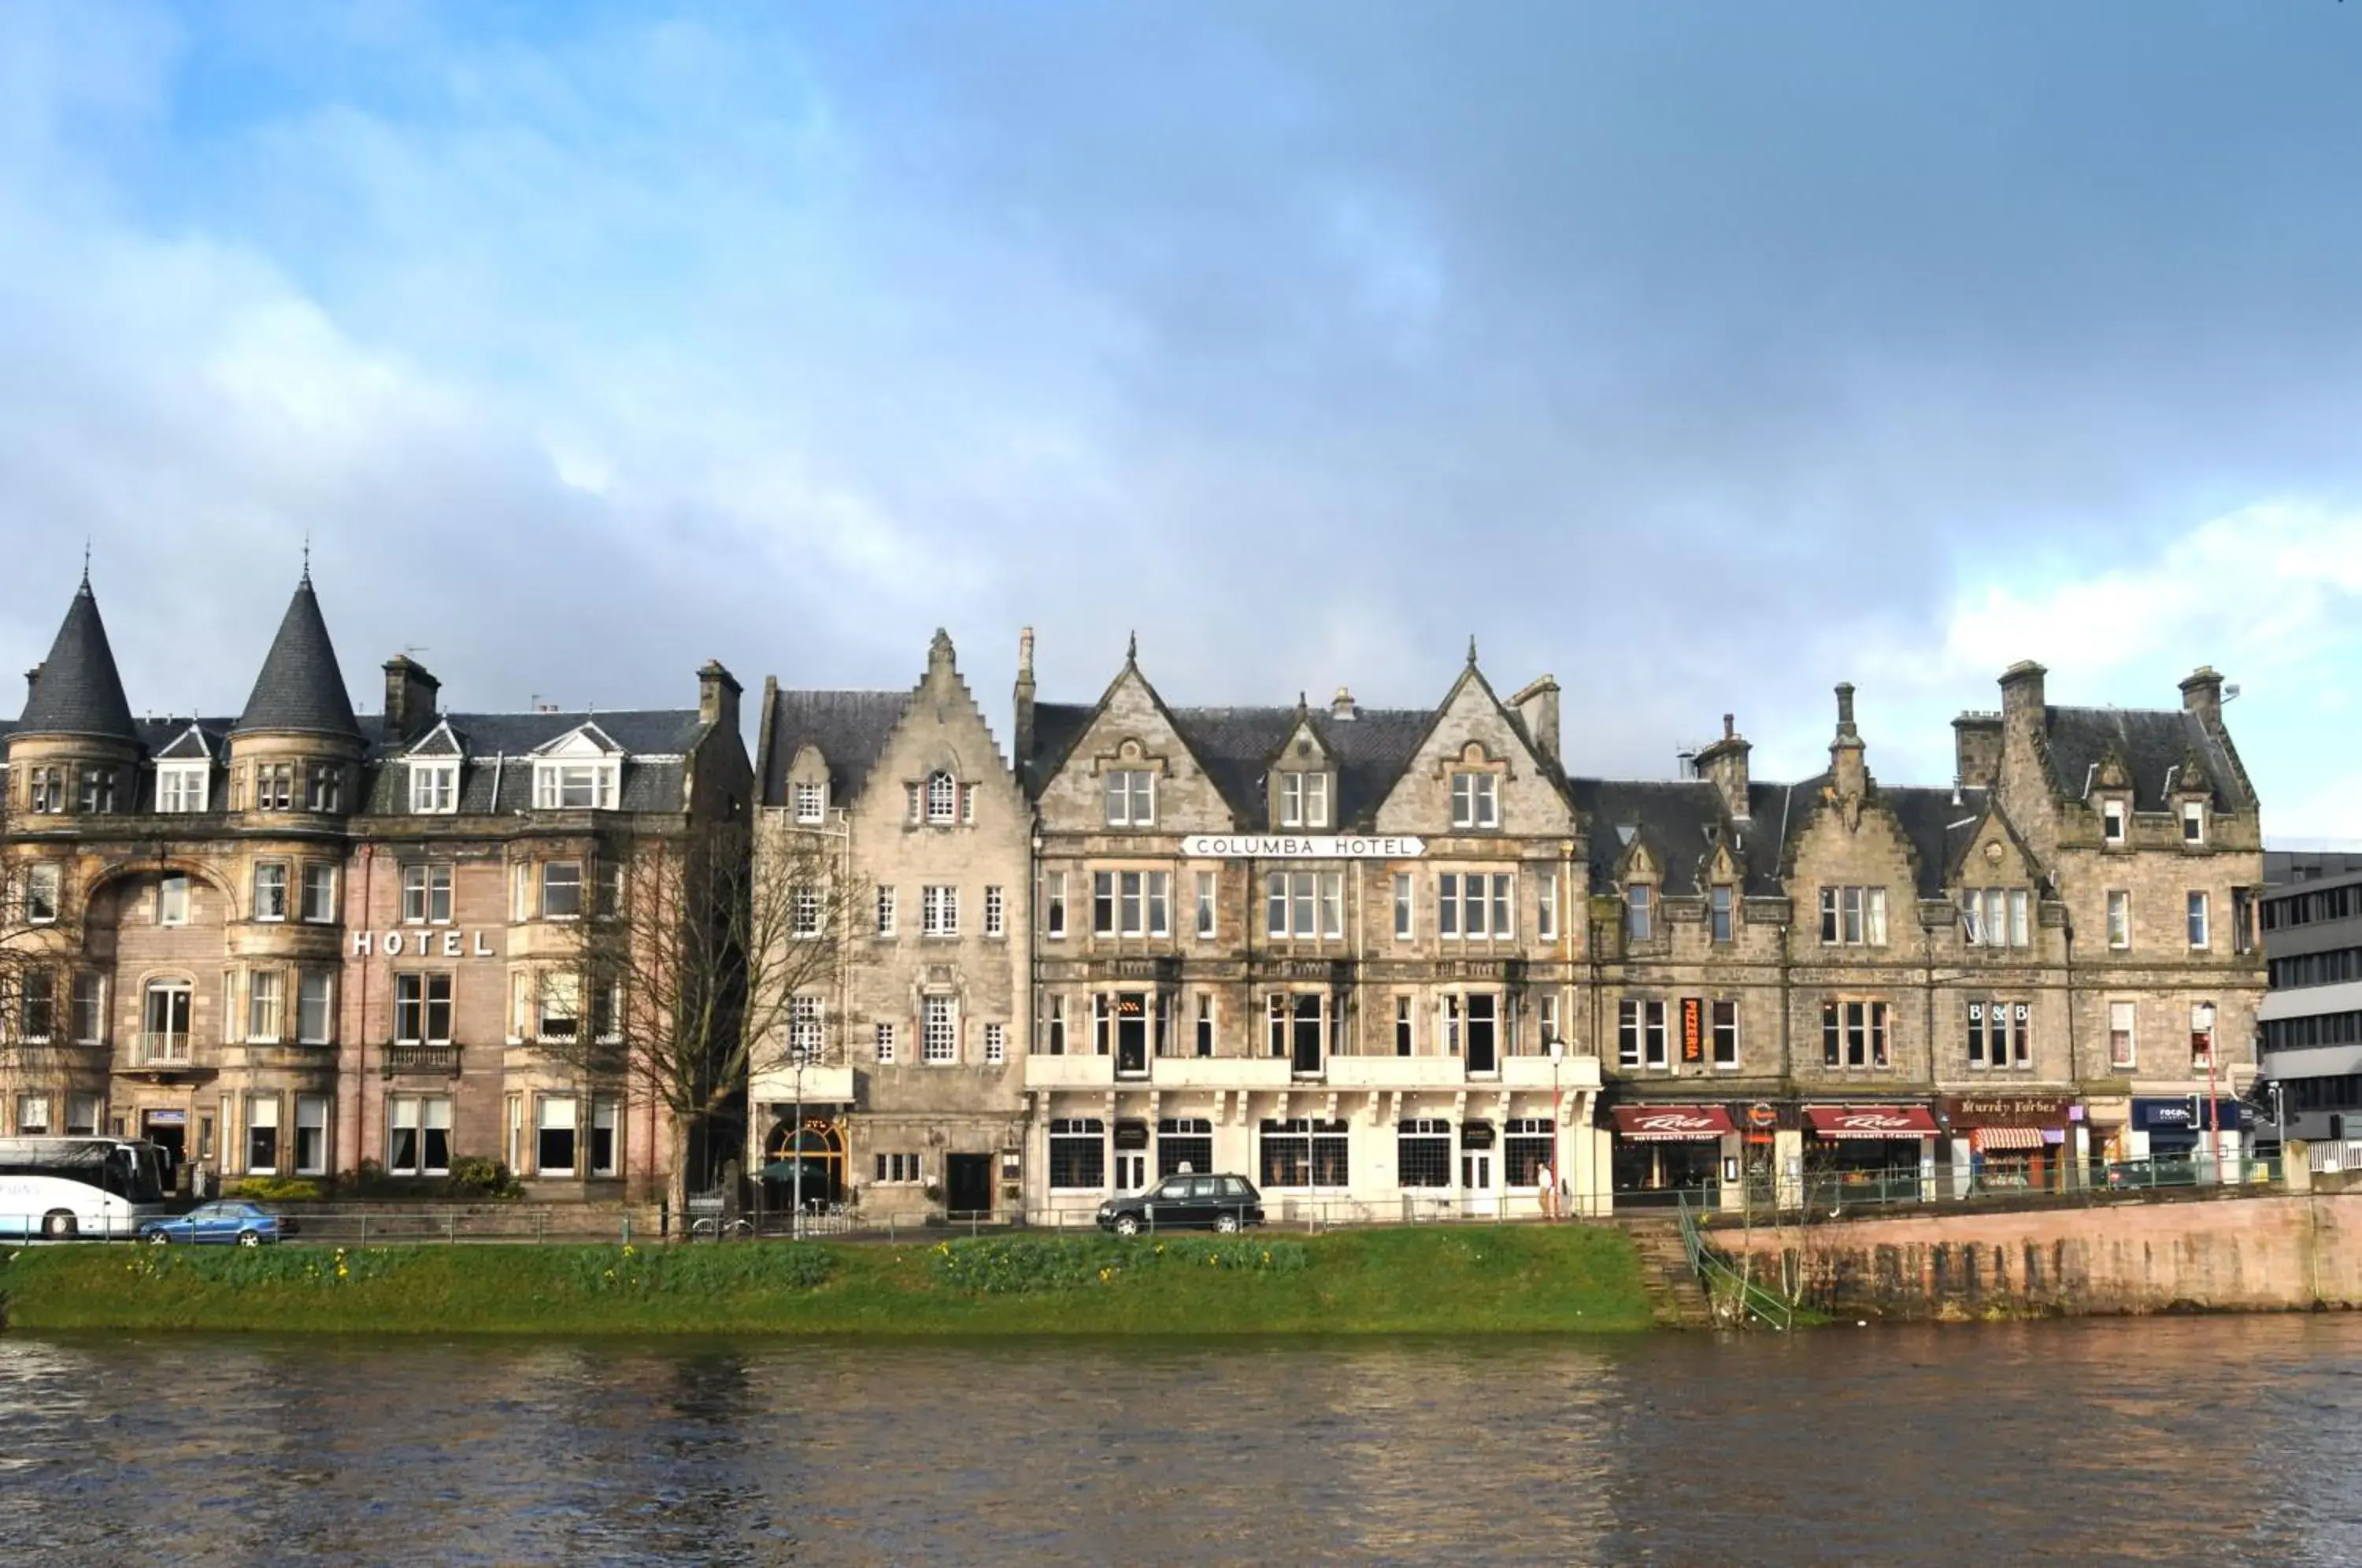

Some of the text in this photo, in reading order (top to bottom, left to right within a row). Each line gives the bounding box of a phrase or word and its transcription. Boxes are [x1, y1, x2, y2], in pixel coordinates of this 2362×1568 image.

[1197, 839, 1411, 854] COLUMBA HOTEL
[352, 930, 495, 956] HOTEL
[1969, 1004, 2027, 1021] B & B
[1685, 1000, 1698, 1059] PIZZERIA
[2015, 1100, 2057, 1113] Forbes
